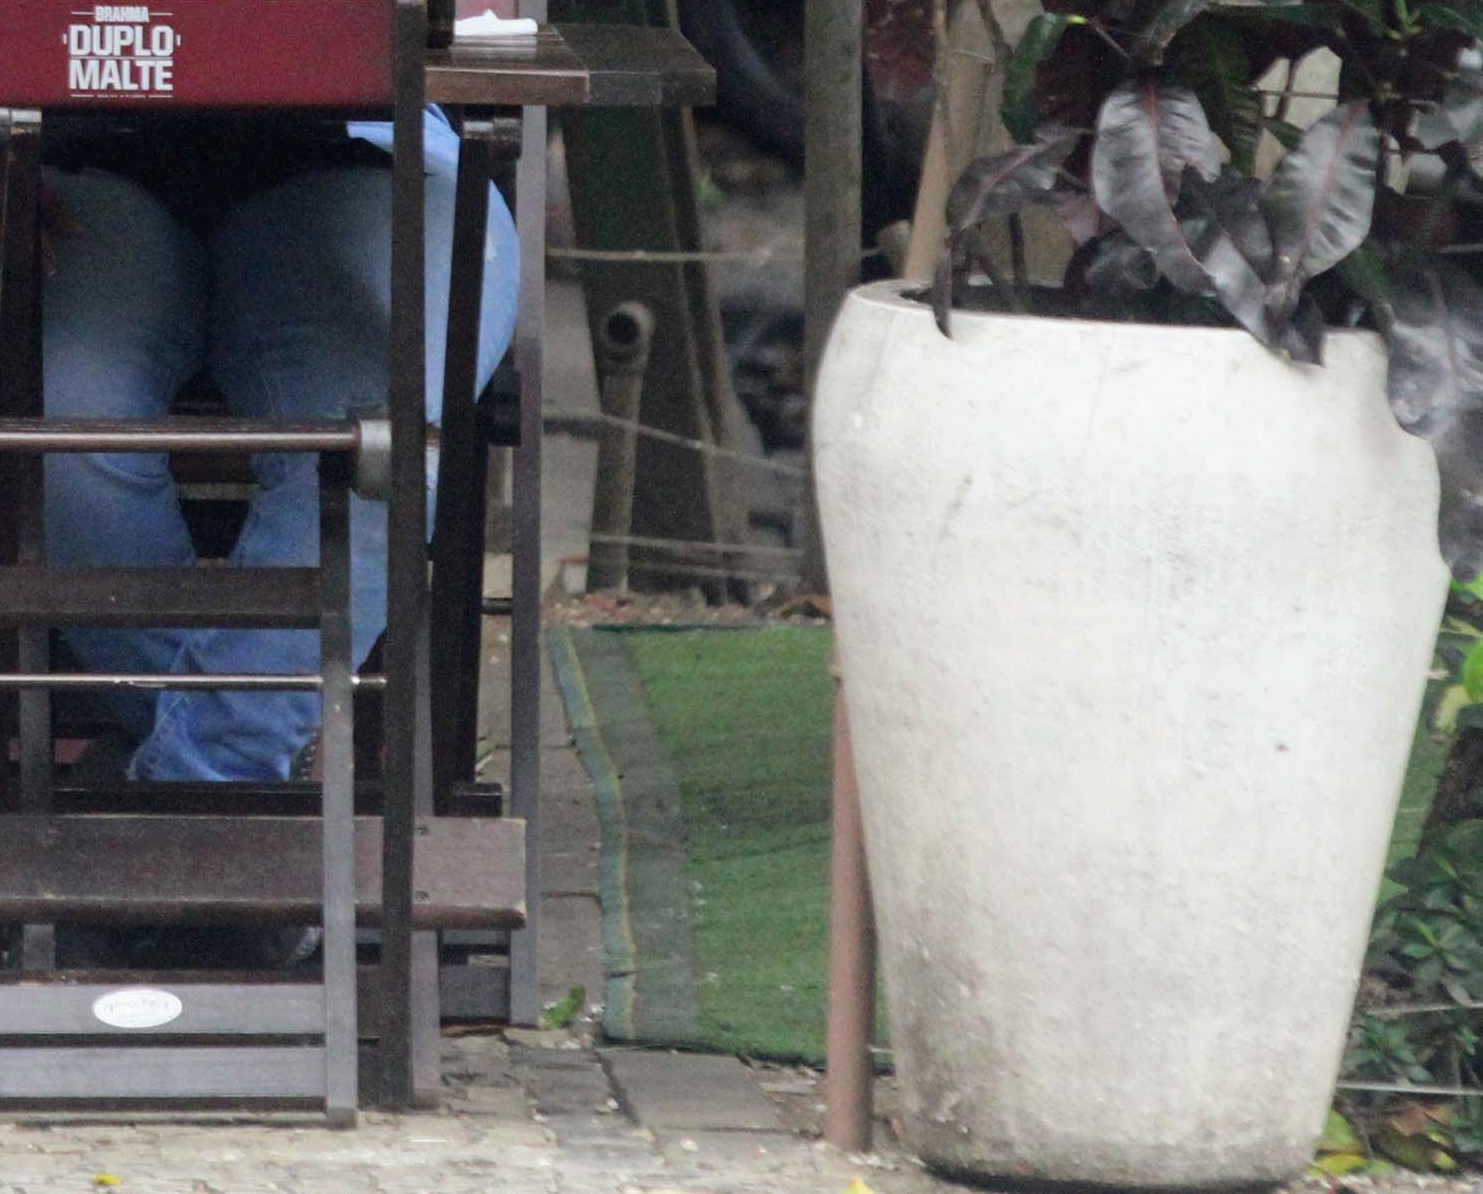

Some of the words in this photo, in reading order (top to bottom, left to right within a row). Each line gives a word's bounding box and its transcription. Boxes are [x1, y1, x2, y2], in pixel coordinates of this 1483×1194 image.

[95, 5, 149, 22] BRAHMA
[69, 24, 174, 56] DUPLO
[70, 59, 174, 90] MALTE
